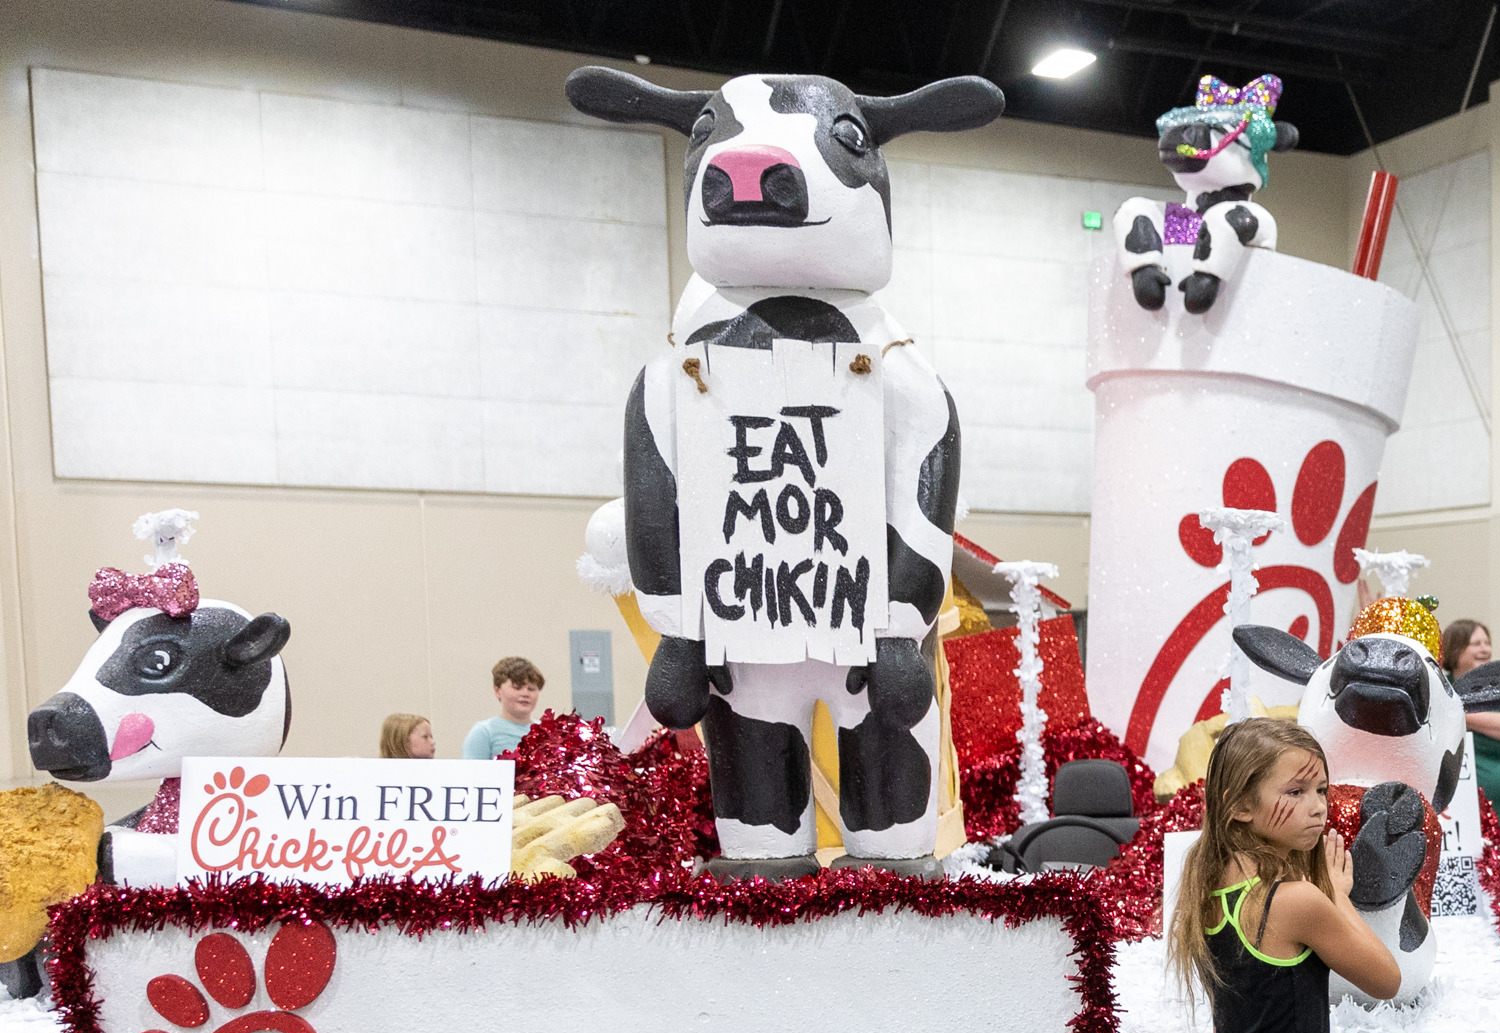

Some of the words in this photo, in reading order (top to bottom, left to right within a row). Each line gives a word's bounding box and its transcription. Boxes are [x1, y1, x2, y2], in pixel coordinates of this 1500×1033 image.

[726, 404, 843, 488] EAT
[723, 483, 849, 557] MOR
[704, 549, 871, 645] CHIKIN
[274, 783, 360, 821] Win
[375, 785, 503, 823] FREE
